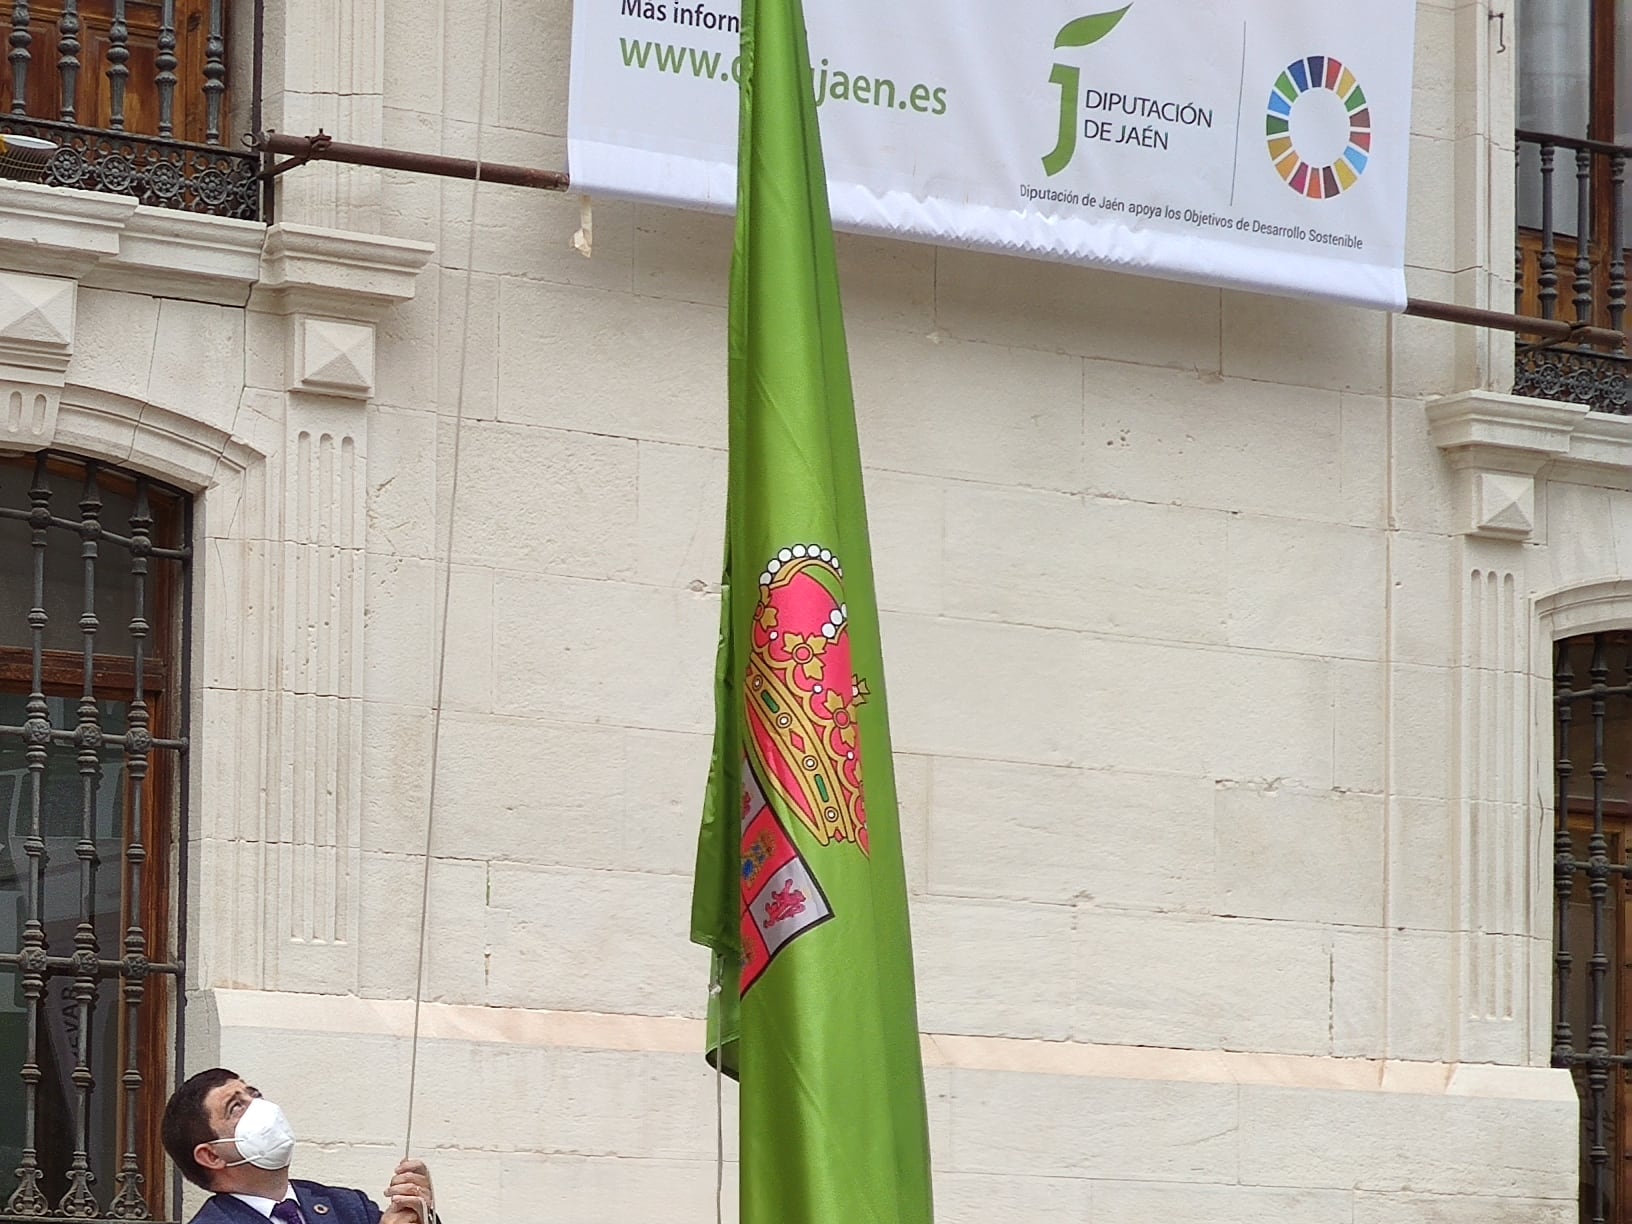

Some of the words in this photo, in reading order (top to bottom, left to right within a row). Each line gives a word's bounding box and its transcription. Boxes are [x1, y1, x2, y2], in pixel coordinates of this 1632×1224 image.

[619, 37, 947, 115] www.jaen.es
[1084, 119, 1113, 142] DE
[1115, 125, 1169, 150] JAÉN
[1085, 89, 1213, 128] DIPUTACIÓN
[1020, 184, 1079, 205] Diputación
[1081, 193, 1097, 208] de
[1099, 197, 1125, 212] Jaén
[1128, 202, 1162, 219] apoya
[1164, 205, 1181, 221] los
[1184, 209, 1233, 228] Objetivos
[1236, 217, 1250, 231] de
[1252, 220, 1306, 241] Desarrollo
[1308, 229, 1363, 250] Sostenible
